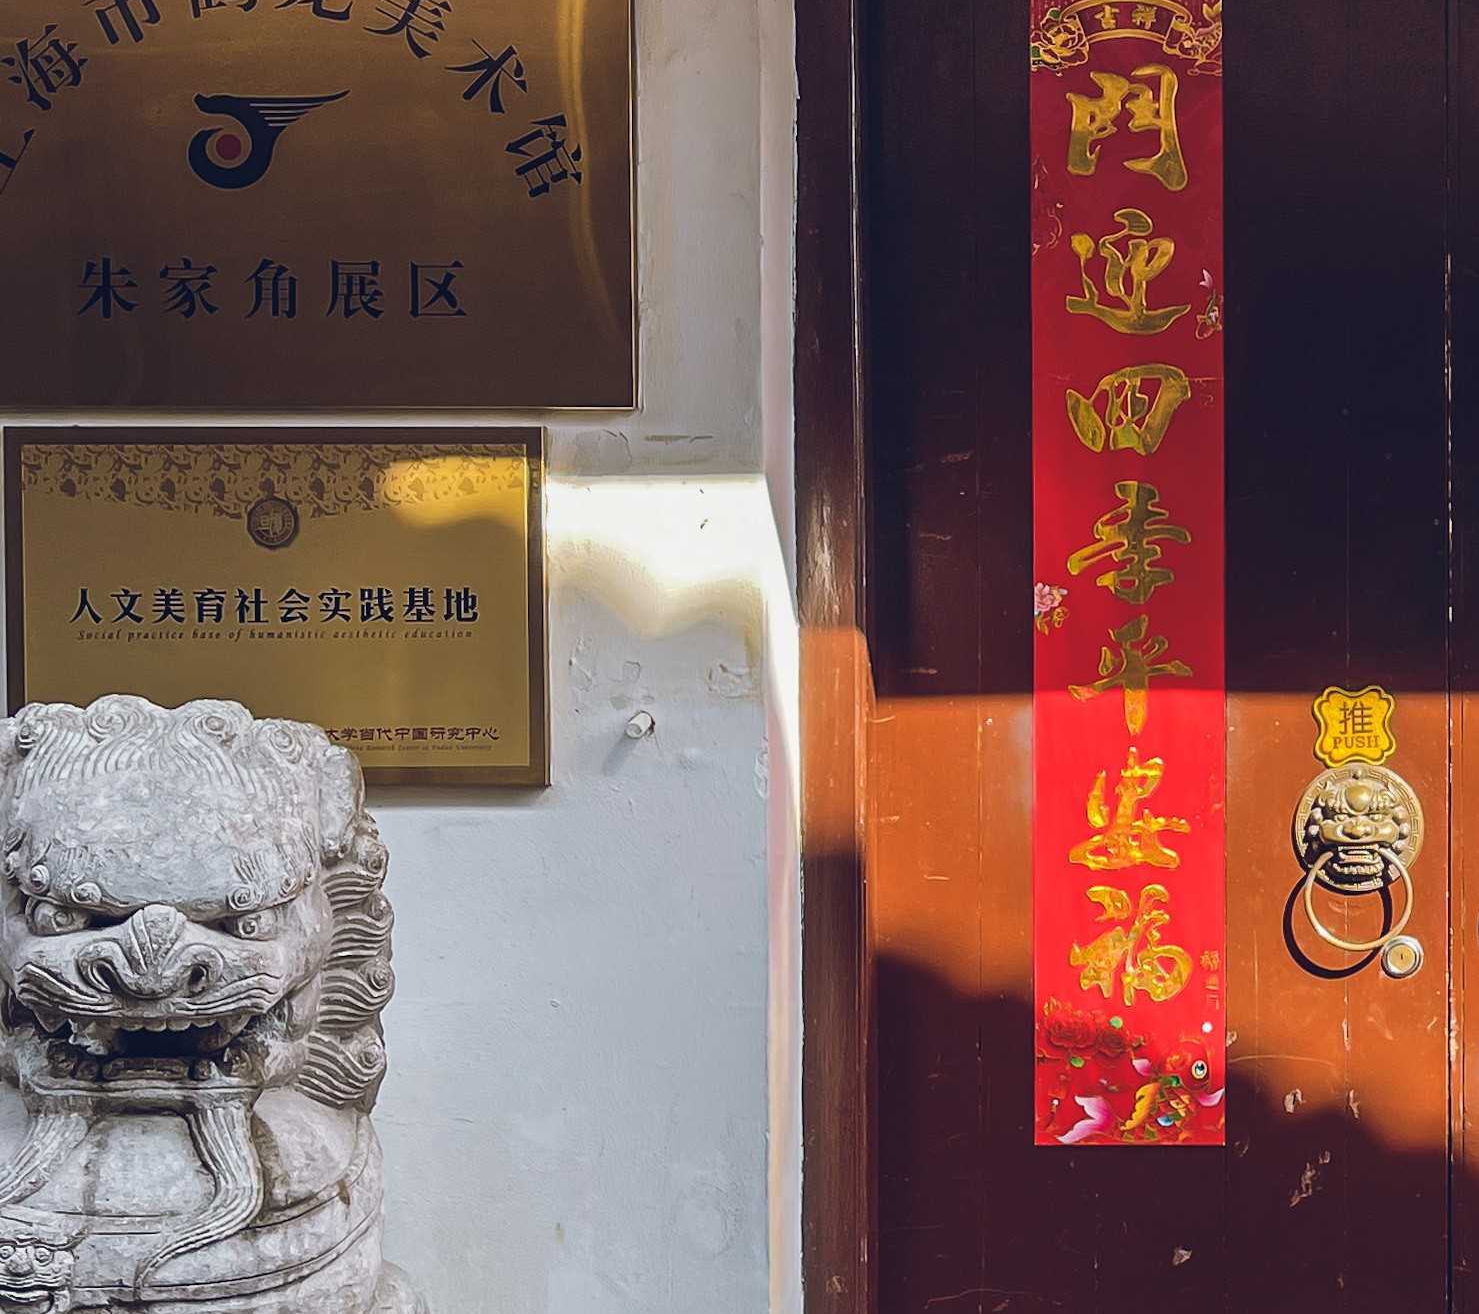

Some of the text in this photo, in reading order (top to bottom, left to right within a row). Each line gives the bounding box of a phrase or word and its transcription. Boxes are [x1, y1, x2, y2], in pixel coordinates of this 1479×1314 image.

[1094, 3, 1158, 30] 吉祥
[76, 256, 469, 321] 朱家角展区
[69, 586, 481, 625] 人文美育社会实践基地
[127, 629, 185, 642] practice
[191, 628, 220, 640] base
[227, 628, 243, 642] of
[1339, 700, 1374, 735] 推
[1332, 735, 1381, 750] PUSH
